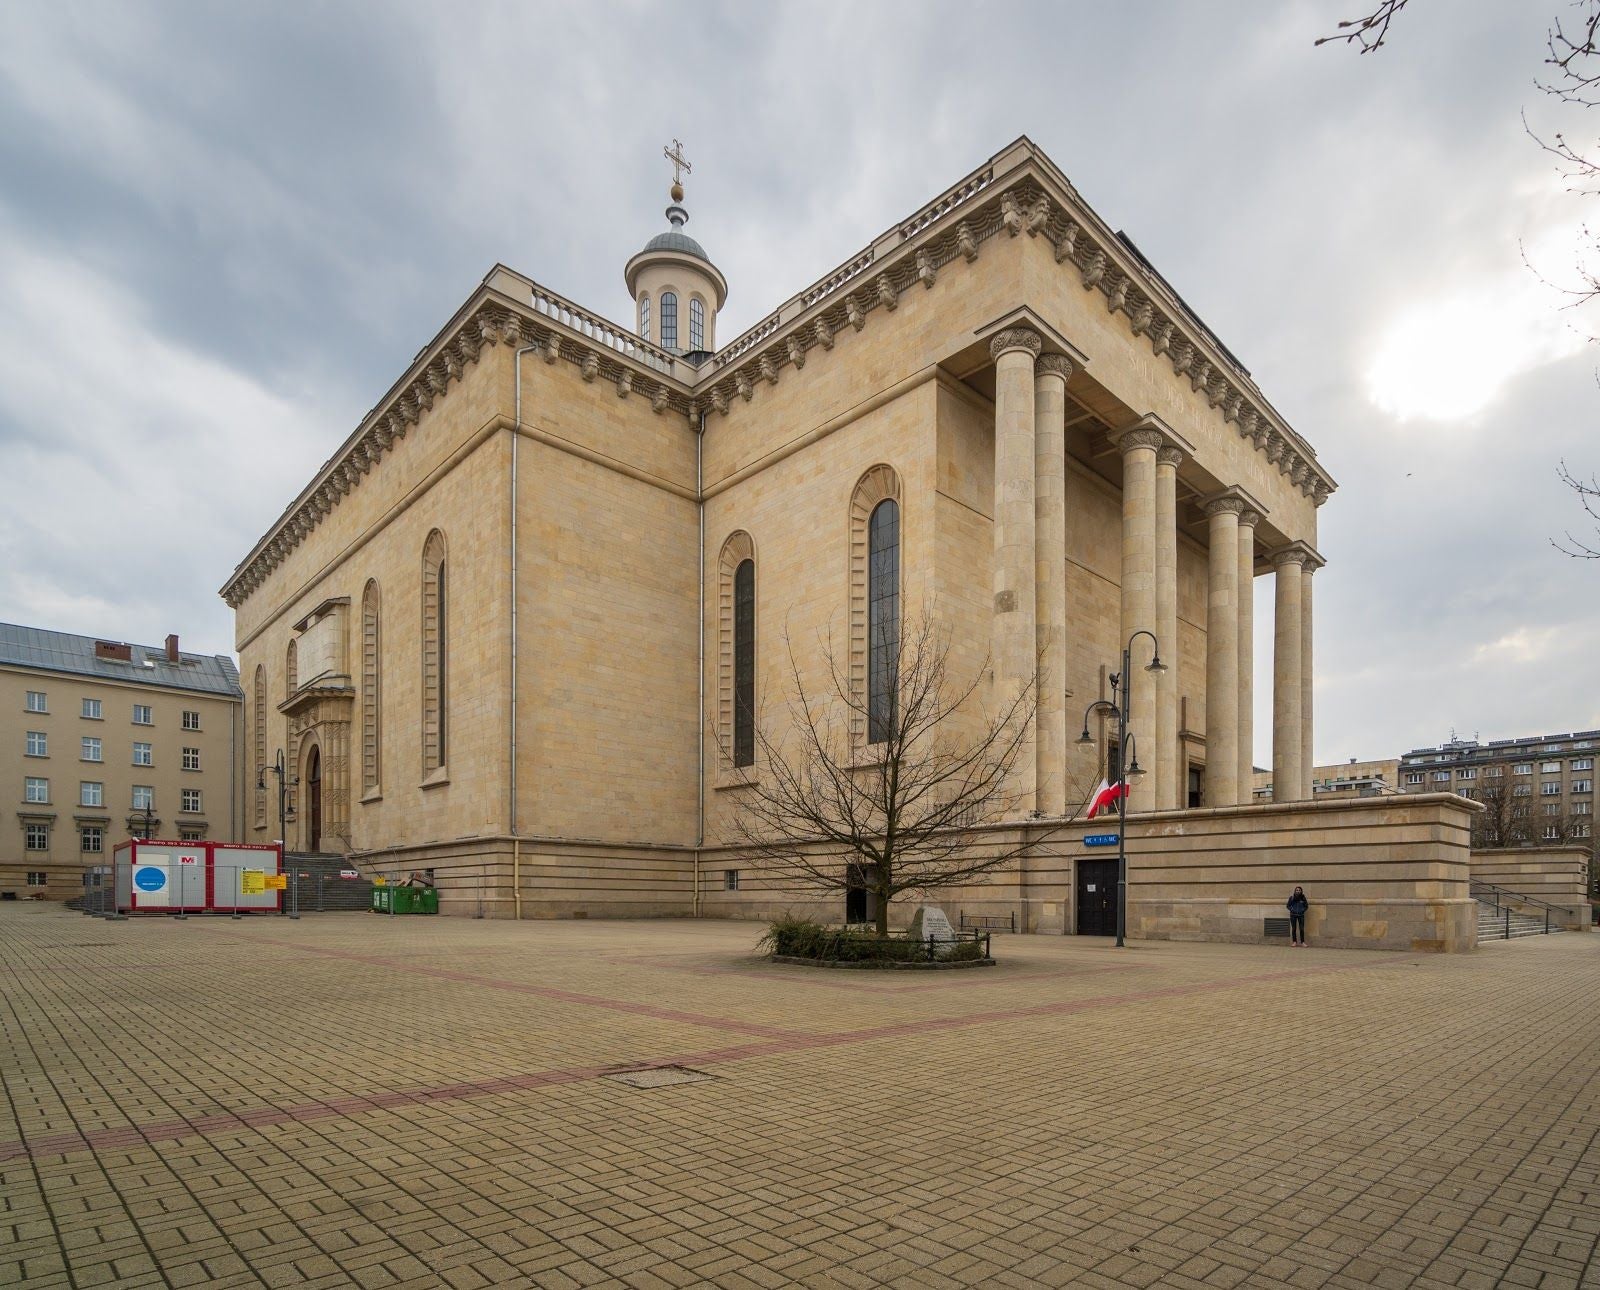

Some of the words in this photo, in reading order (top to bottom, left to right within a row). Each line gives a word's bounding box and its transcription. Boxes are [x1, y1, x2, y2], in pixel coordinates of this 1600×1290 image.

[1128, 348, 1154, 385] SOLI
[1165, 382, 1184, 415] DEO
[1228, 441, 1239, 464] ET
